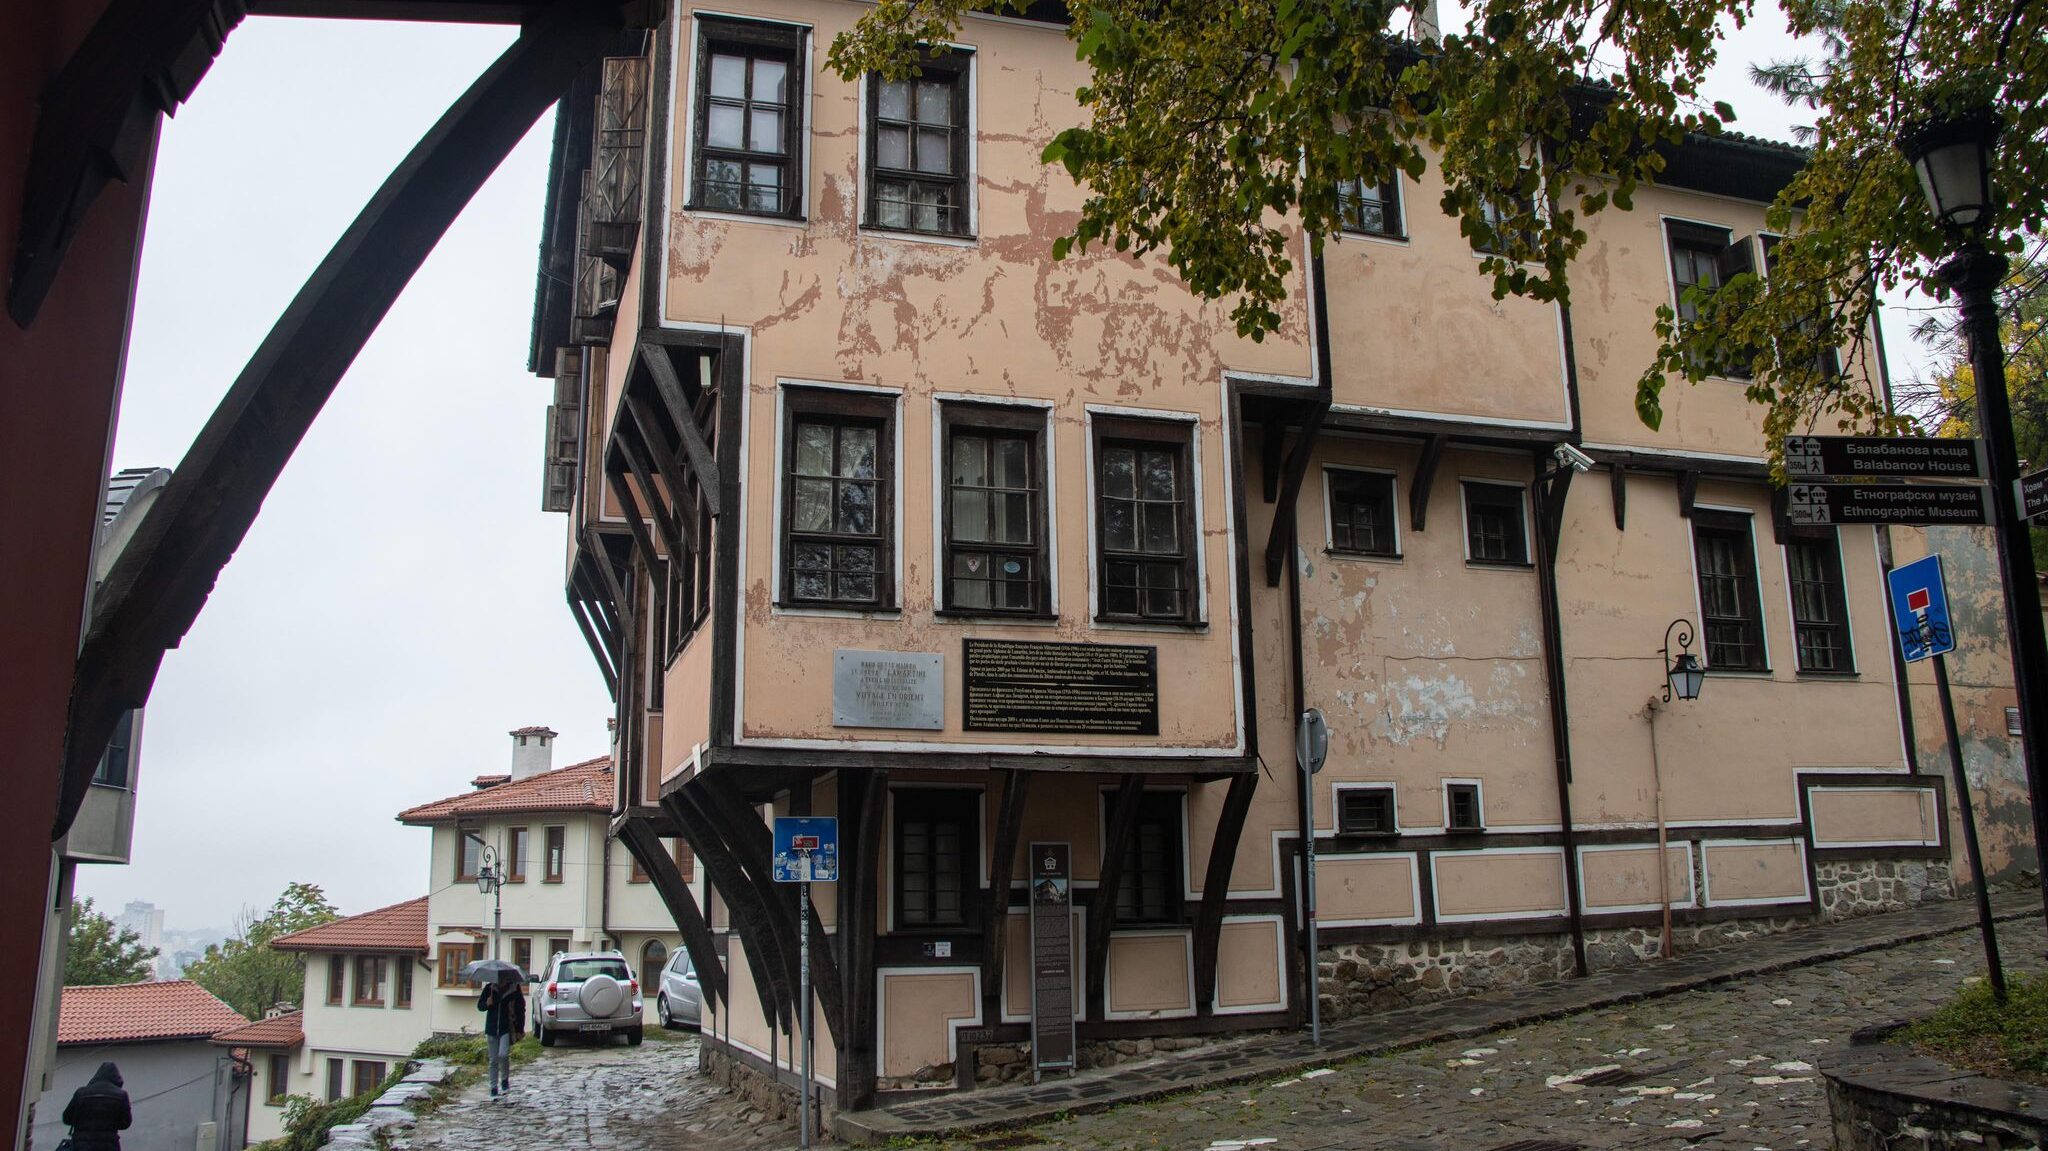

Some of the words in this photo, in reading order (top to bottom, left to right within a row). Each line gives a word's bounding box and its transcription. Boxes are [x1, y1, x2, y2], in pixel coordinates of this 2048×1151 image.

[1846, 443, 1929, 455] Балабанова
[1933, 446, 1968, 457] къща
[1853, 459, 1924, 470] Balabanov
[1928, 461, 1971, 471] House
[1853, 489, 1935, 501] Етнографски
[1938, 490, 1976, 502] музей
[2026, 498, 2041, 508] The
[1843, 506, 1925, 518] Ethnographic
[1928, 507, 1978, 518] Museum
